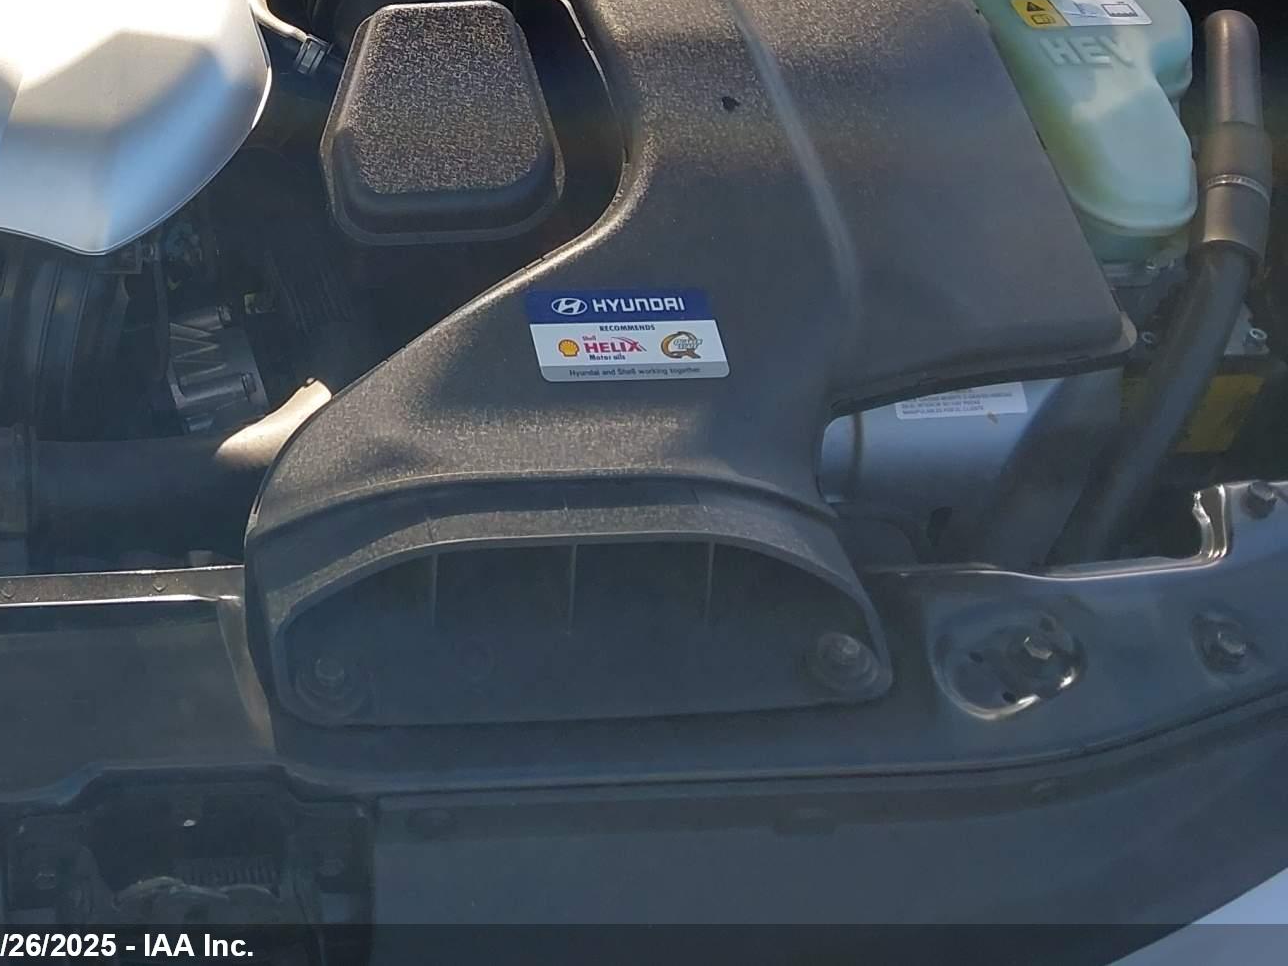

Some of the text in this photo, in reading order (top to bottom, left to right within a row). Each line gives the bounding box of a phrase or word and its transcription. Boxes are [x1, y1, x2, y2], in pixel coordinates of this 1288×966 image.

[1039, 34, 1135, 68] HEV
[592, 297, 685, 313] HYUNDAI
[599, 324, 655, 332] RECOMMENDS
[583, 339, 643, 354] HELIX
[589, 353, 612, 361] Motor
[569, 369, 601, 378] Hyundai
[638, 367, 668, 376] working
